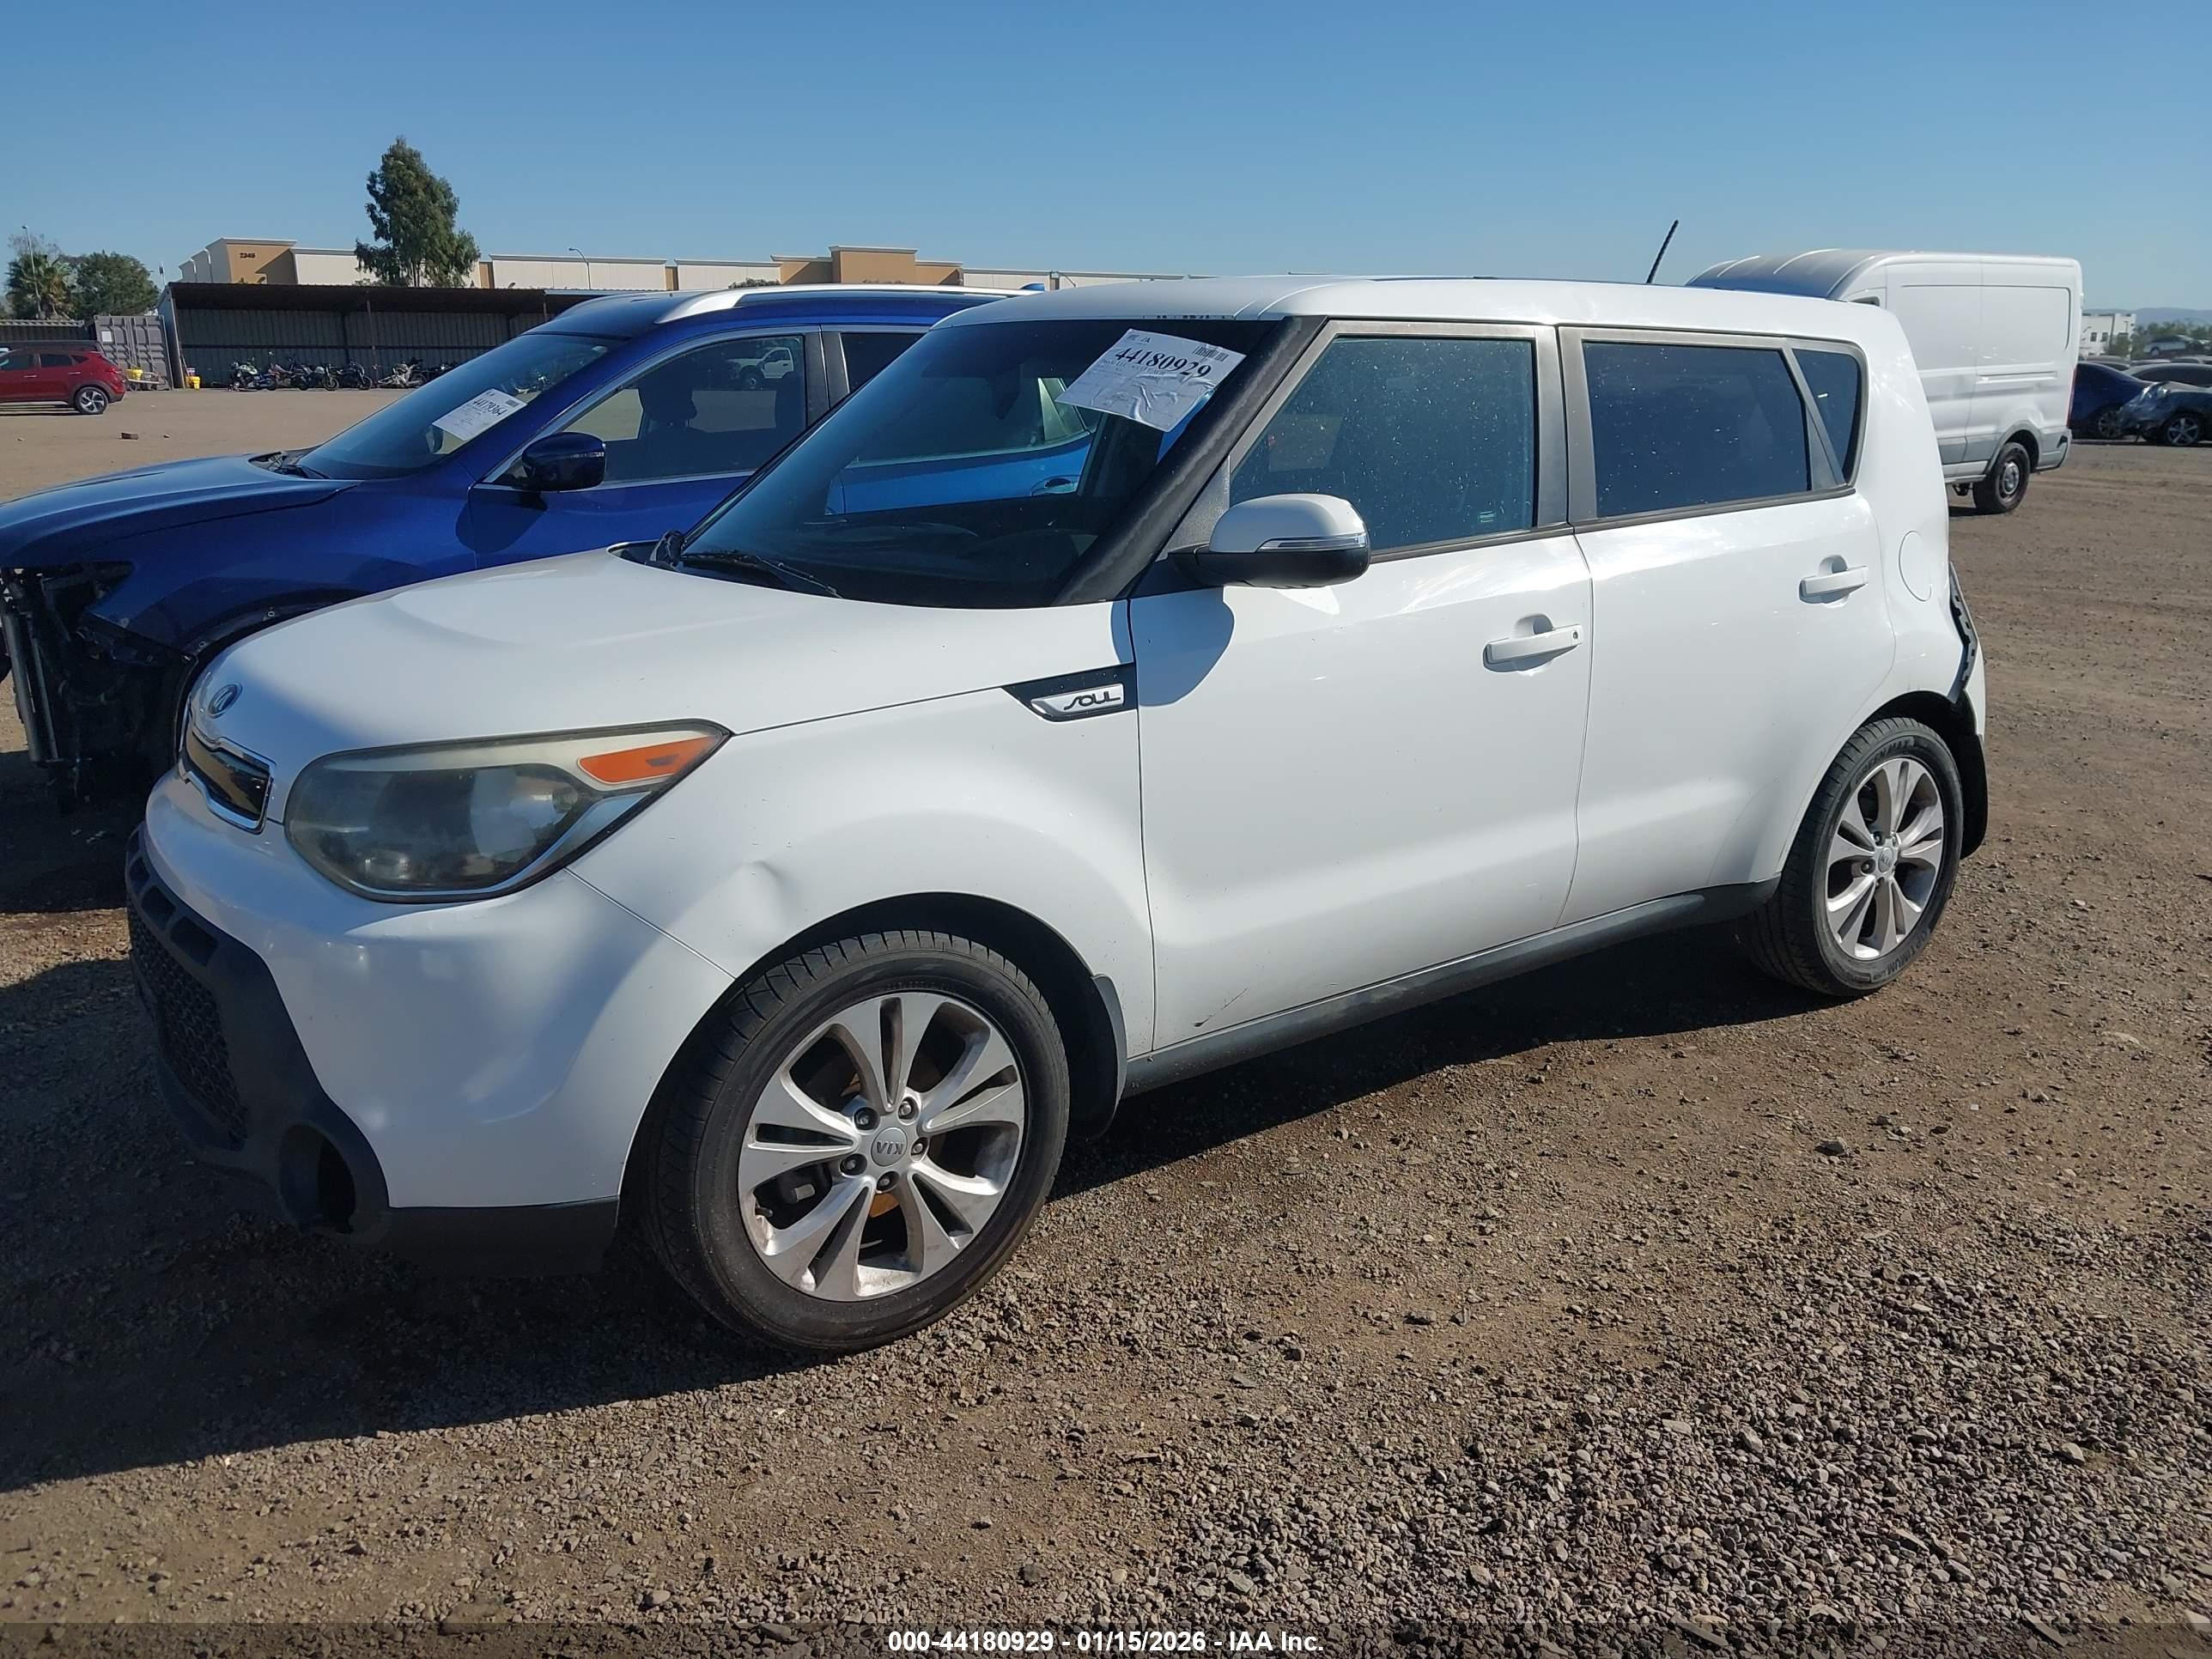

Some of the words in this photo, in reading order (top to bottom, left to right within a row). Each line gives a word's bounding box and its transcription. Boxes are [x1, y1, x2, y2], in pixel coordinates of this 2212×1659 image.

[1115, 347, 1212, 378] 44180929
[1063, 690, 1121, 710] SOUL
[876, 1139, 904, 1155] KIA
